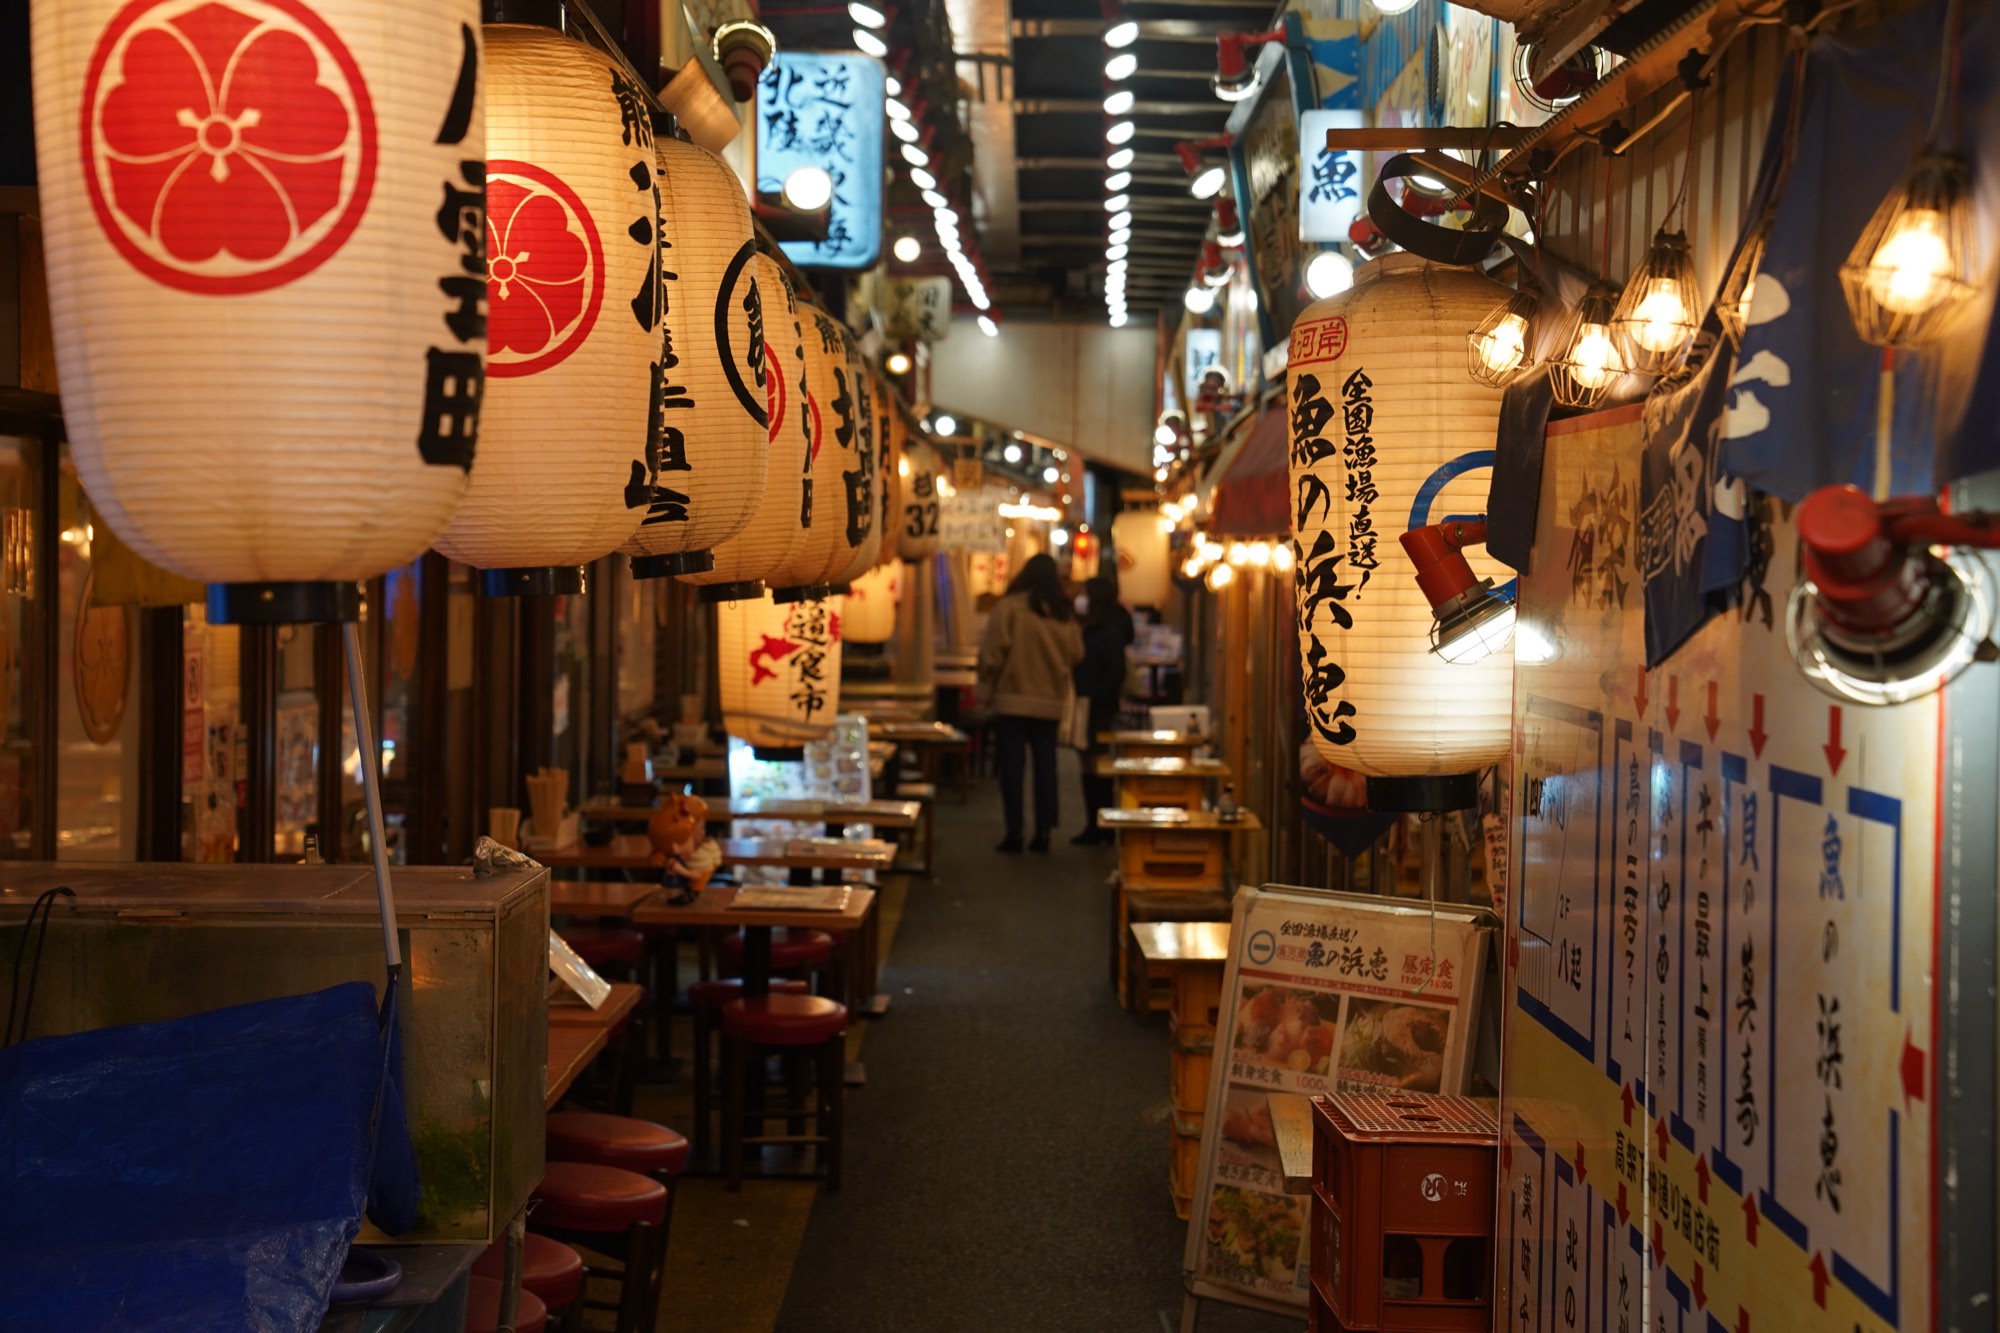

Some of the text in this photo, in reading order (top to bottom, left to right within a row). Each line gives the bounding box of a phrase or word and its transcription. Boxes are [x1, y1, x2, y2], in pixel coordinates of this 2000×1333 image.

[1308, 147, 1358, 204] 魚
[1290, 373, 1357, 746] 魚の浜恵
[1559, 894, 1571, 921] 2F
[1305, 941, 1389, 982] 魚の浜恵
[1402, 954, 1455, 980] 昼定食
[1557, 937, 1582, 992] 八起
[1815, 812, 1845, 1214] 魚の浜恵
[1231, 1062, 1282, 1086] 刺身定食
